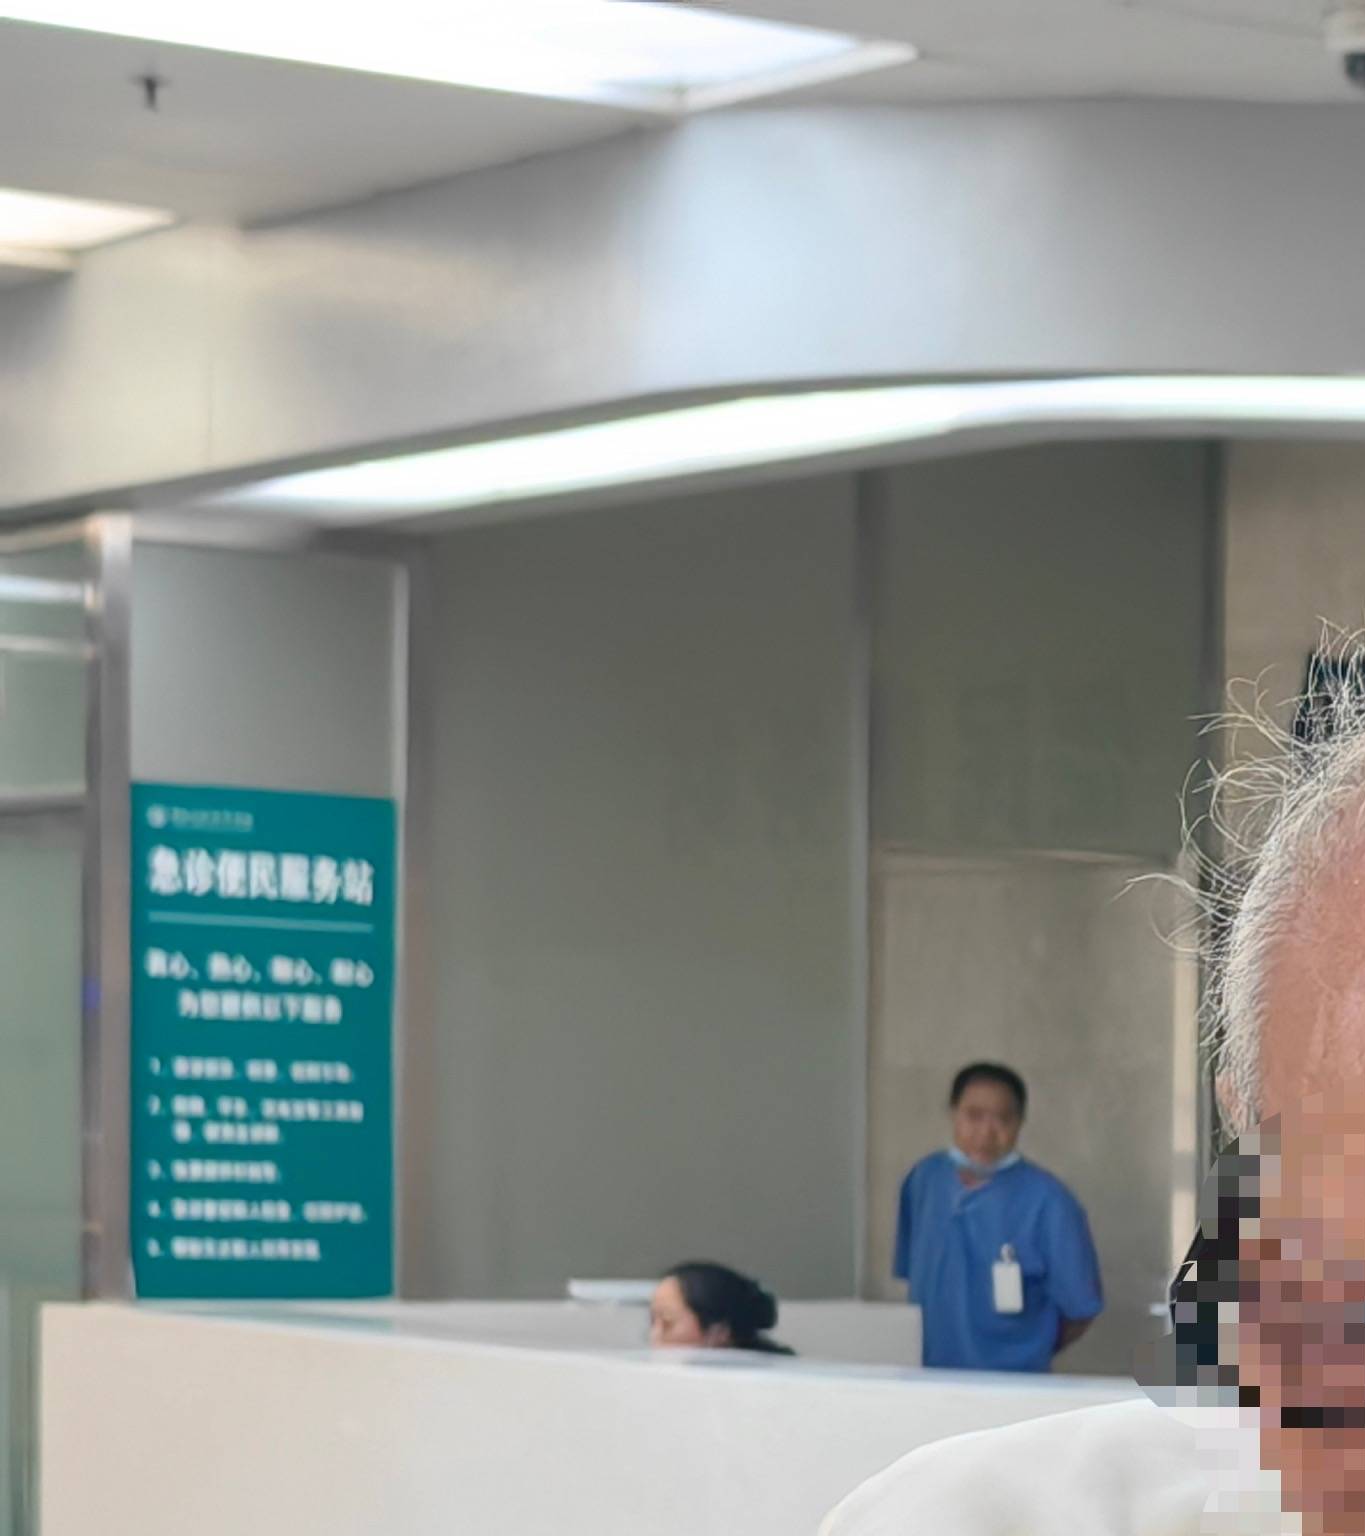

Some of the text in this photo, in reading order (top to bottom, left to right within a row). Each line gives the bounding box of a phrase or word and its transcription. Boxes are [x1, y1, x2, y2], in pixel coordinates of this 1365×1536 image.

[147, 845, 376, 906] 急诊便民服务站
